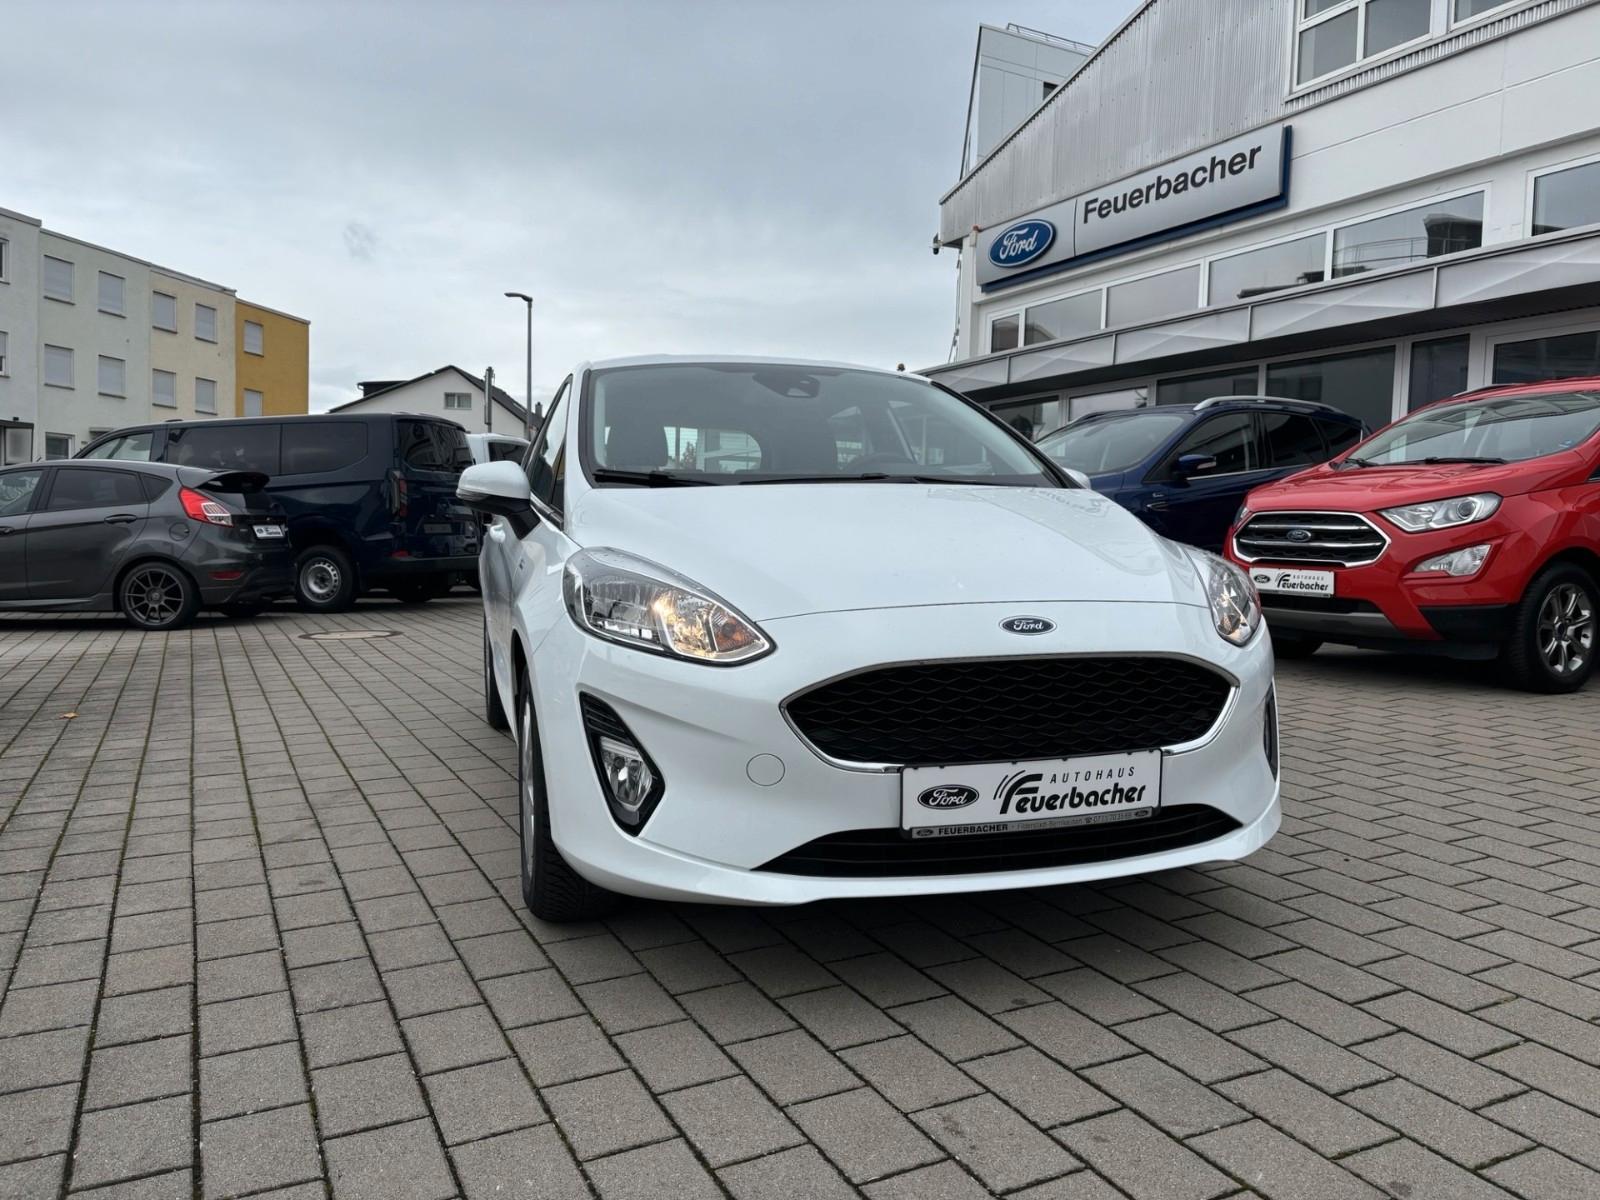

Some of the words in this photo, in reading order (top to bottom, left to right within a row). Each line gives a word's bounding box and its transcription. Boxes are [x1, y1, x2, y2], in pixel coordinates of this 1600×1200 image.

[1083, 145, 1262, 225] Feuerbacher
[999, 226, 1039, 259] Ford
[1277, 574, 1329, 591] Feuerbacher
[1013, 619, 1044, 631] Ford
[1050, 766, 1135, 784] AUTOHAUS
[928, 788, 969, 807] Ford
[999, 773, 1147, 815] Feuerbacher
[938, 824, 1009, 836] FEUERBACHER
